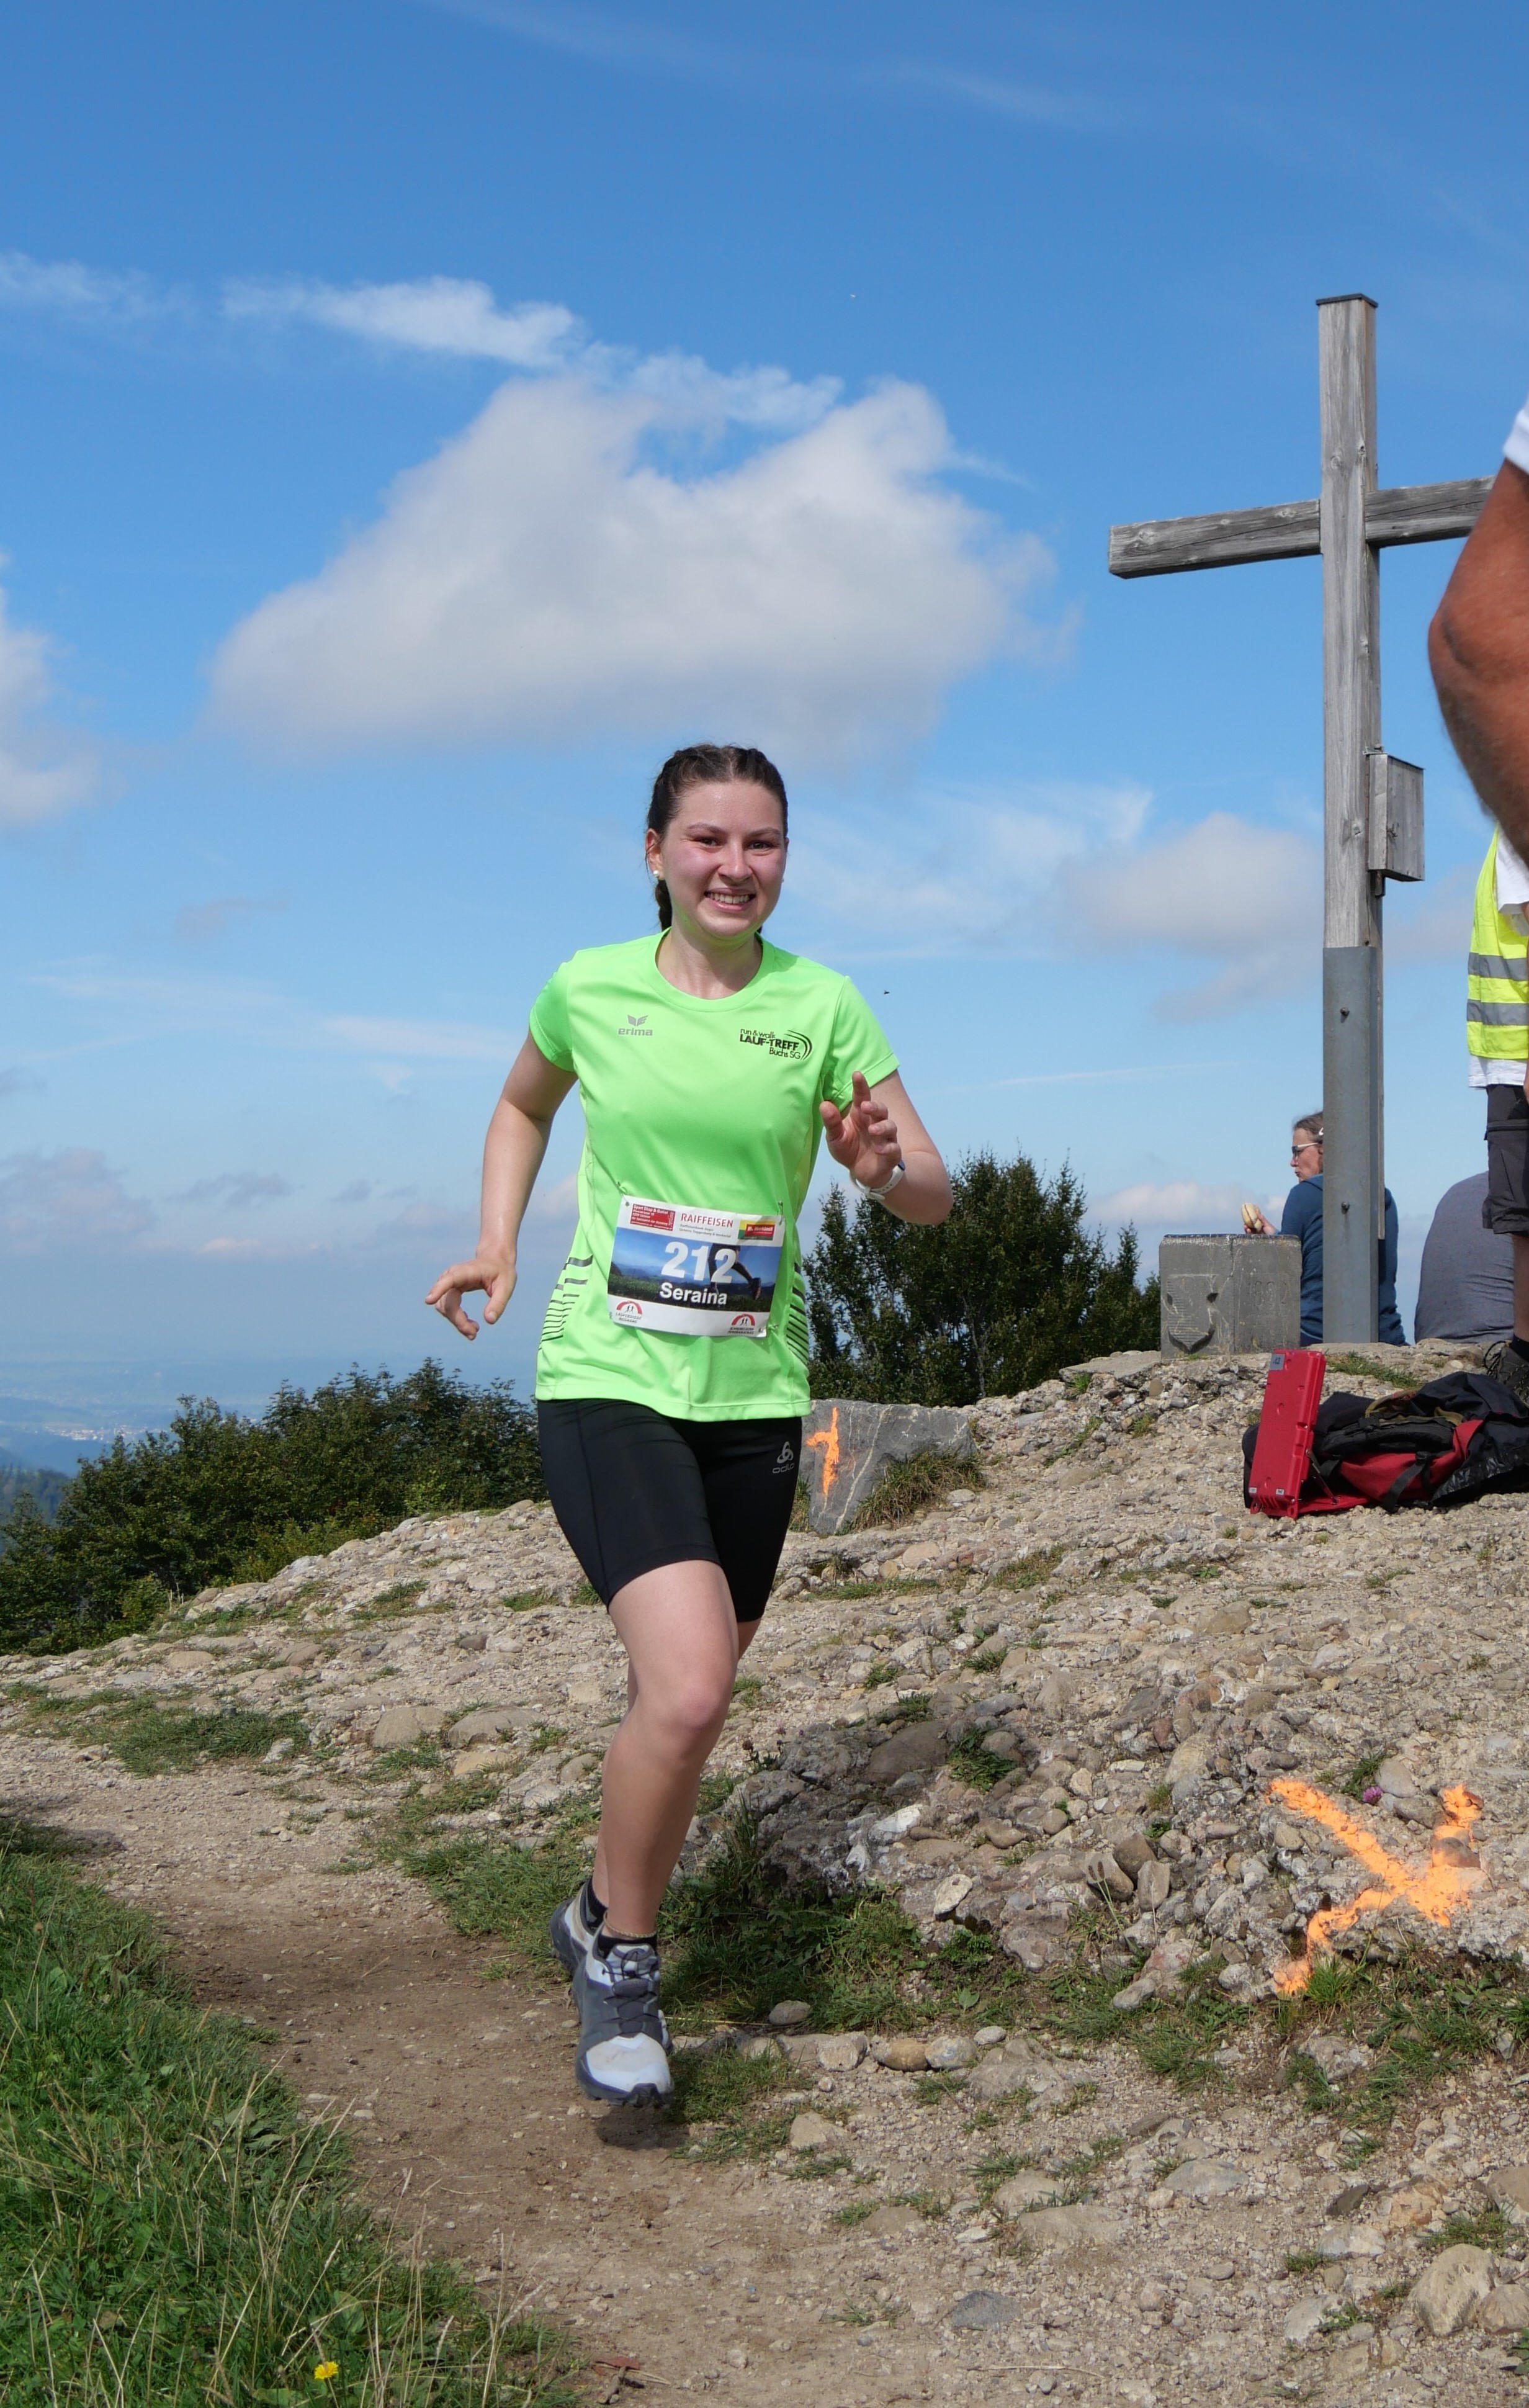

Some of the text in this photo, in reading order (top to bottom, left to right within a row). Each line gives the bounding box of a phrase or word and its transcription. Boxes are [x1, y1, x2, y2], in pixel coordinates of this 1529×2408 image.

[618, 1027, 653, 1036] erima
[758, 1031, 776, 1039] walk
[739, 1033, 800, 1051] LAUF-TREFF
[769, 1047, 801, 1059] Buchs SG
[681, 1213, 734, 1228] RAIFFEISEN
[660, 1241, 737, 1283] 212
[660, 1282, 727, 1305] Seraina
